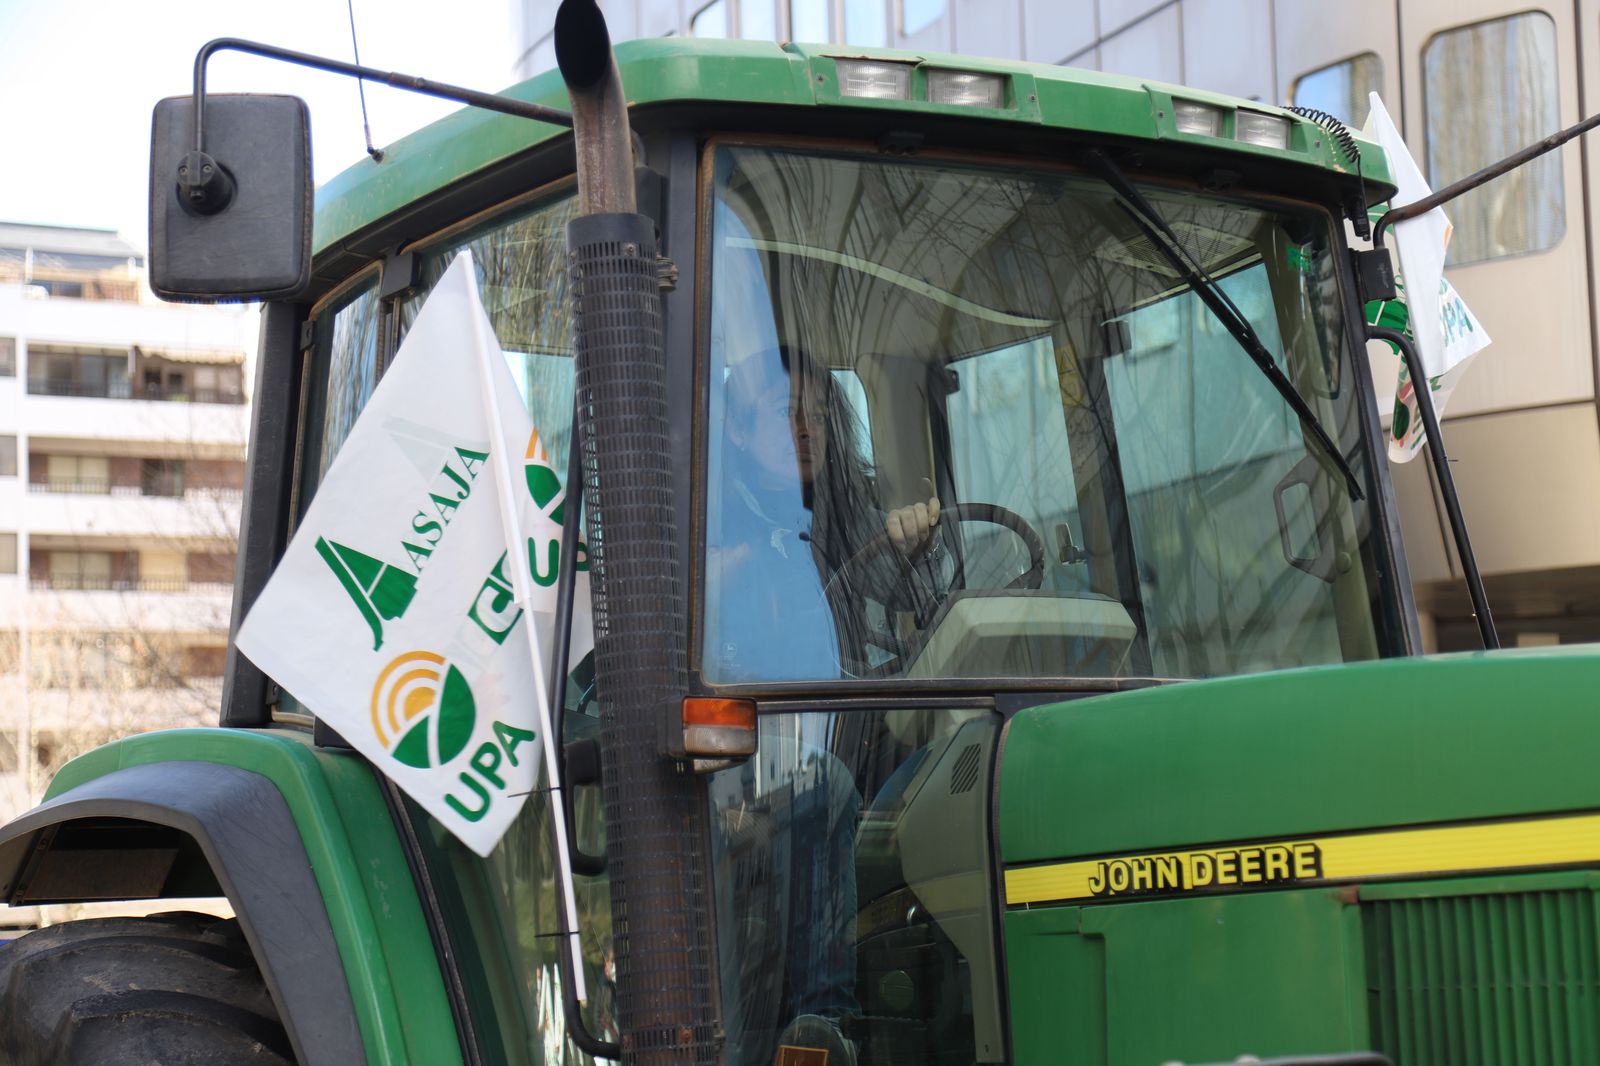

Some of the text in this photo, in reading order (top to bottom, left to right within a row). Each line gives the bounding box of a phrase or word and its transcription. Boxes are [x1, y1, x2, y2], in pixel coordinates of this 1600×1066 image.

[400, 446, 490, 573] ASAJA
[444, 719, 536, 823] UPA
[1087, 842, 1321, 895] JOHN DEERE
